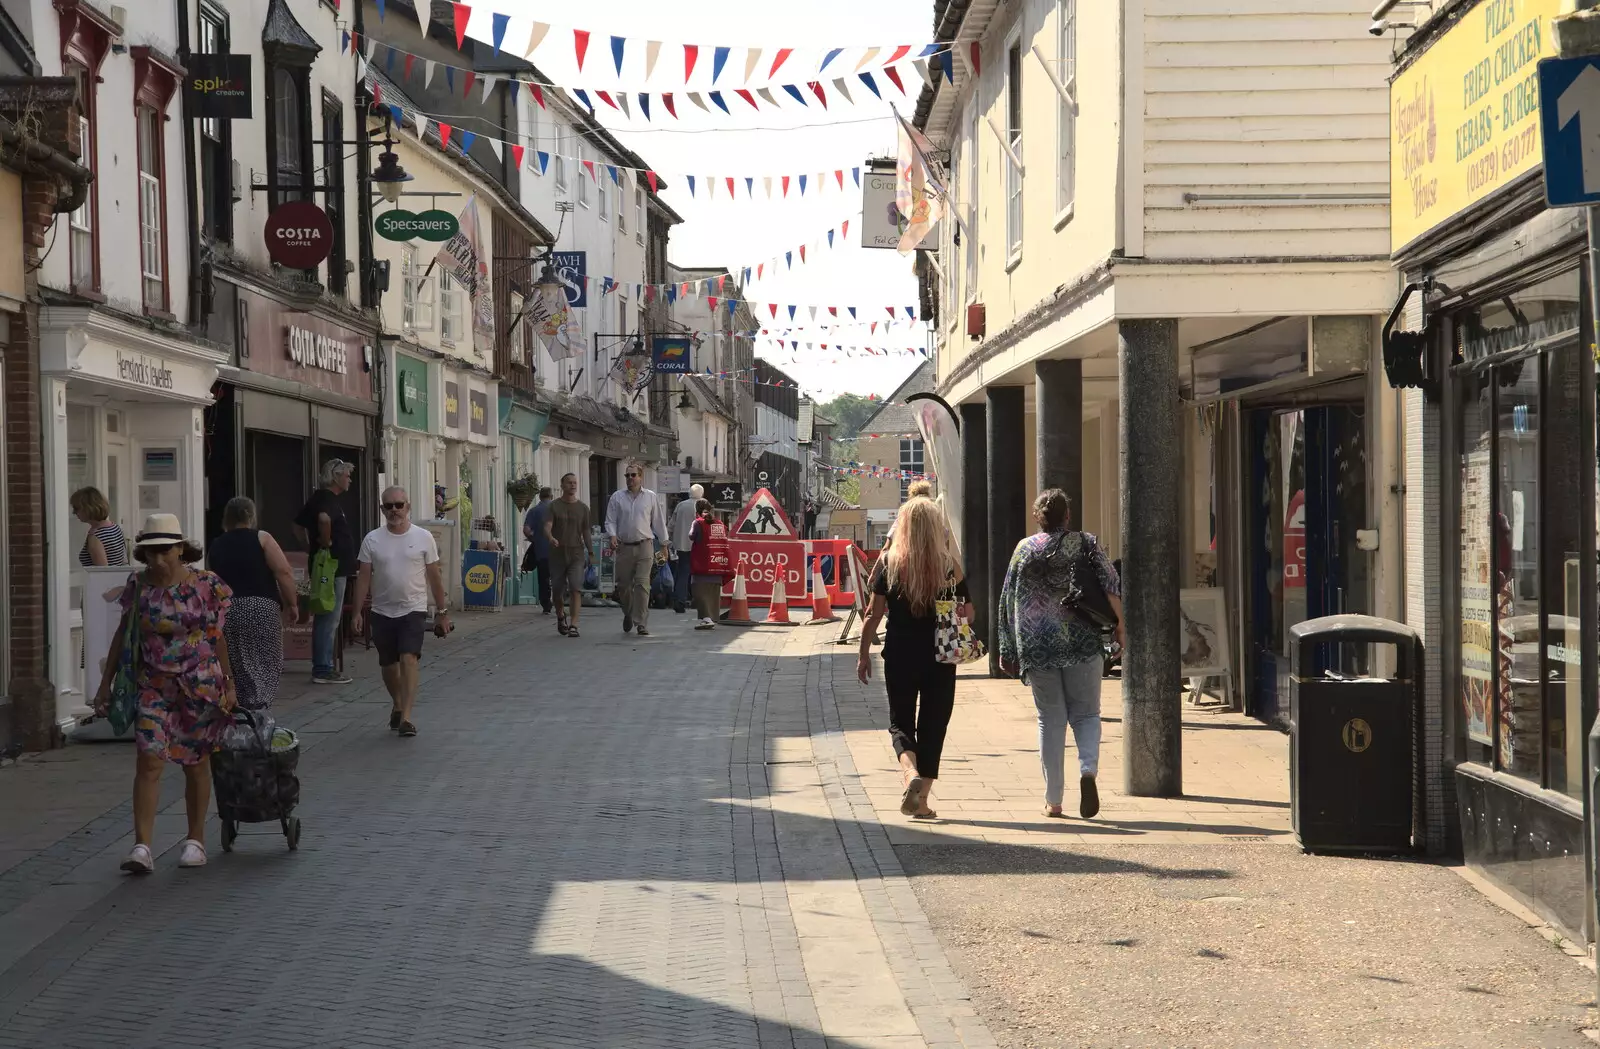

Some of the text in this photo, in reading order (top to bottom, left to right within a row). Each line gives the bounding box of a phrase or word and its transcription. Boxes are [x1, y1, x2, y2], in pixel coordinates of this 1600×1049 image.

[1485, 0, 1515, 43] PIZZA
[1463, 15, 1542, 109] FRIED CHICKEN
[1455, 104, 1492, 163] KEBABS
[1466, 145, 1499, 198] (01379)
[276, 228, 321, 240] COSTA
[383, 218, 450, 232] Specsavers
[288, 324, 347, 375] COSTA COFFEE
[739, 552, 789, 566] ROAD
